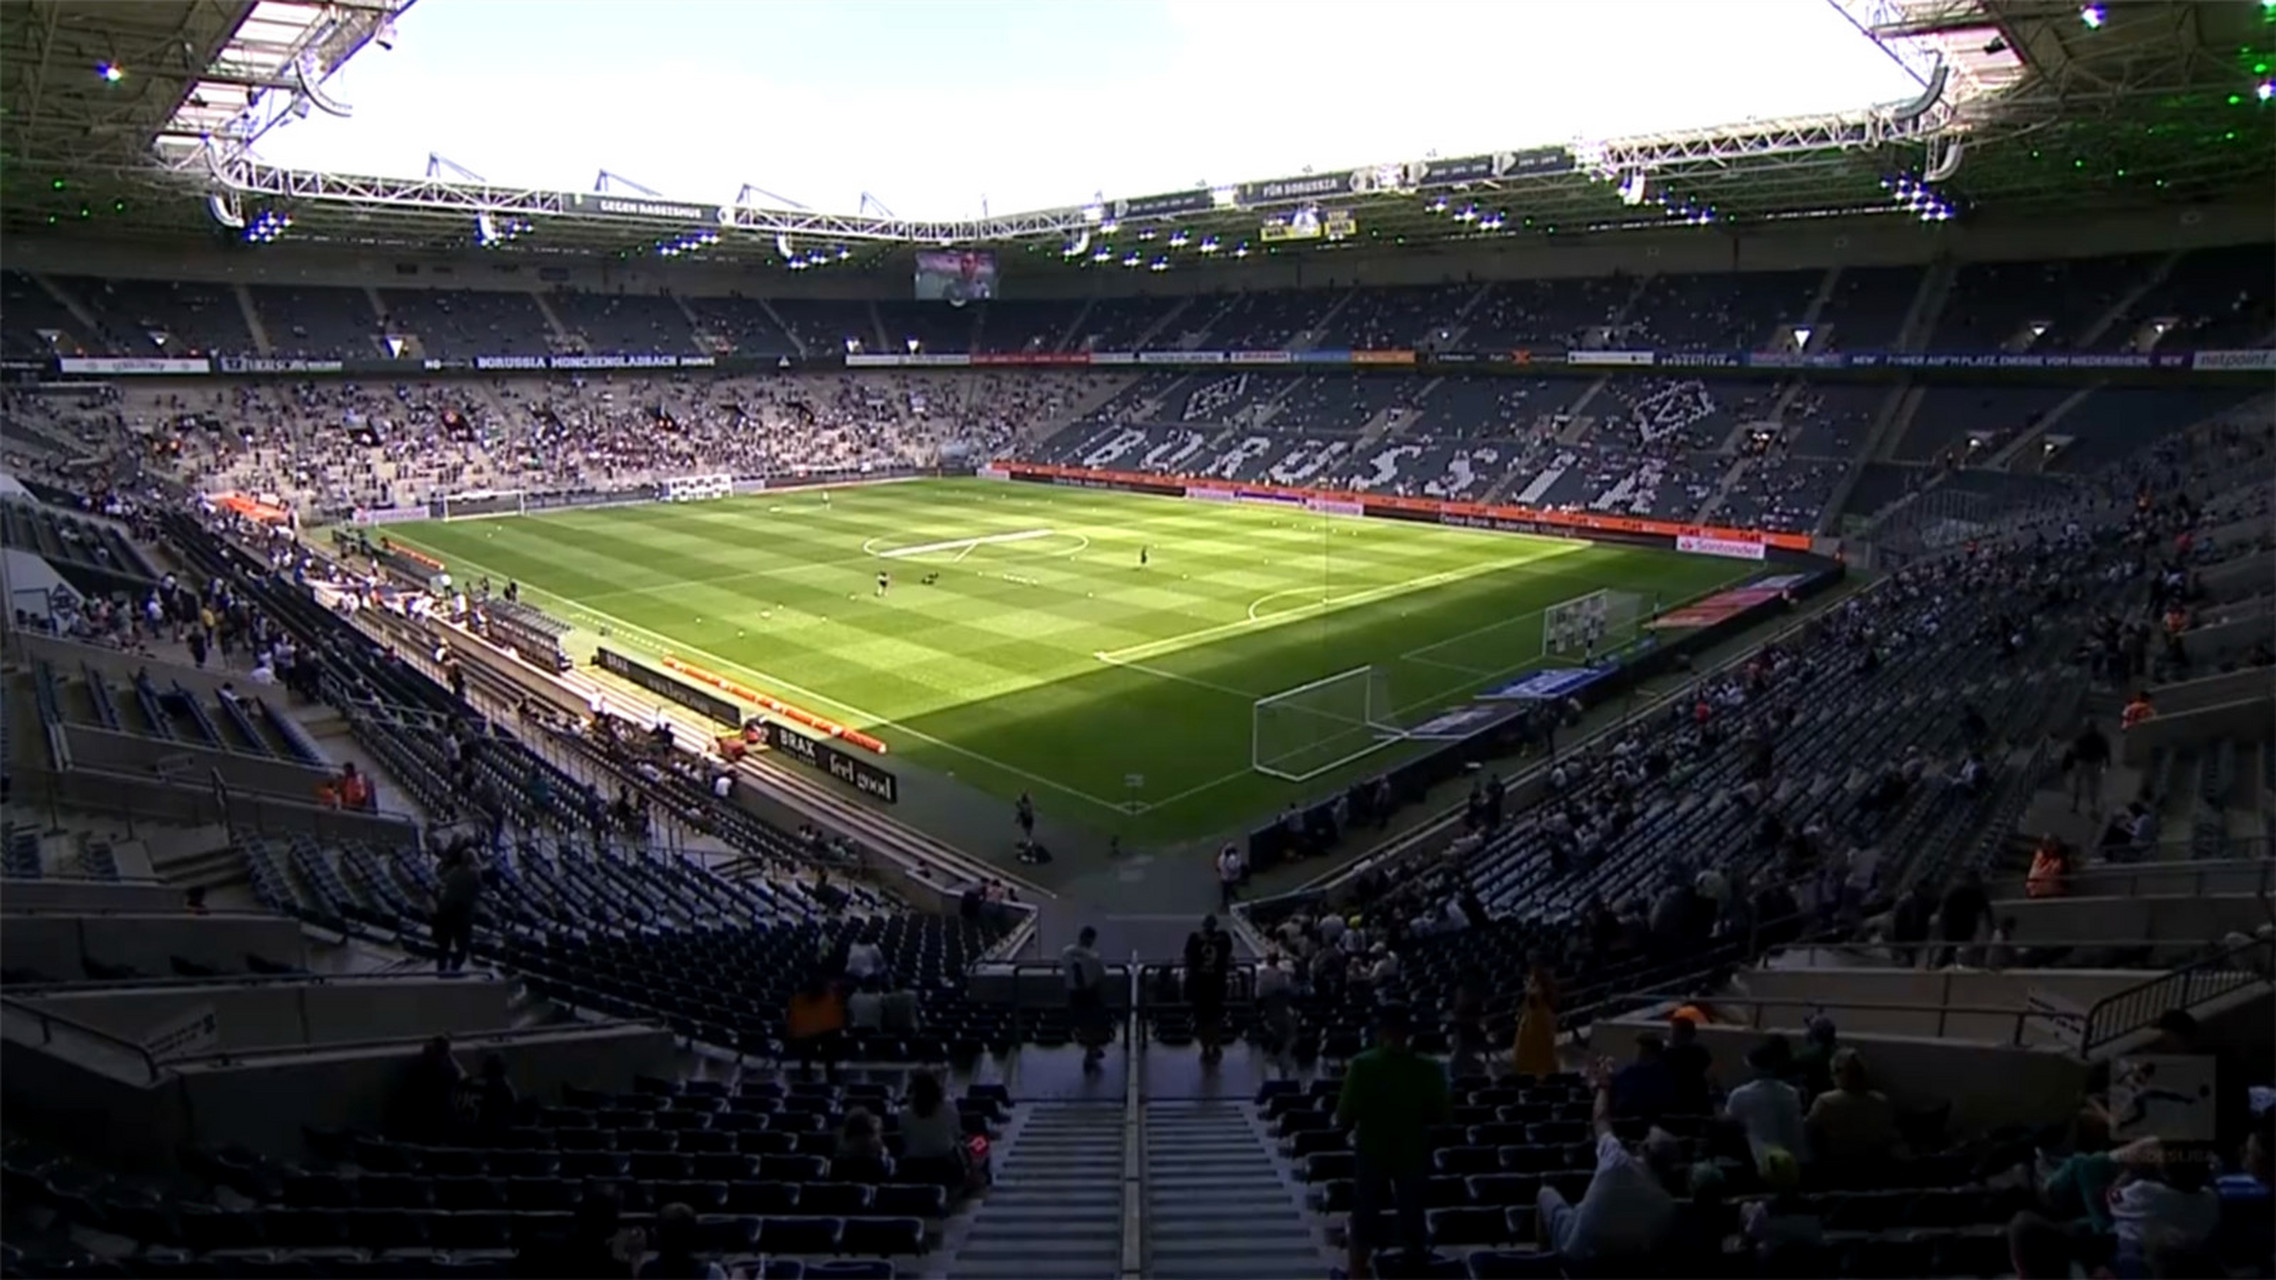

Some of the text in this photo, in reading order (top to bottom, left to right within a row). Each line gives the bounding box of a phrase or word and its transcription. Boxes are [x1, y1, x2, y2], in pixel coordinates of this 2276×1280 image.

[1284, 179, 1338, 196] BORUSSIA
[600, 199, 702, 218] GEGEN RASSISMUS
[477, 356, 546, 368] BORUSSIA
[2201, 353, 2268, 367] netpoint
[1083, 428, 1666, 514] BORUSSIA
[1697, 538, 1760, 555] Santander
[780, 728, 816, 758] BRAX
[829, 752, 855, 782] feel
[856, 776, 891, 801] good
